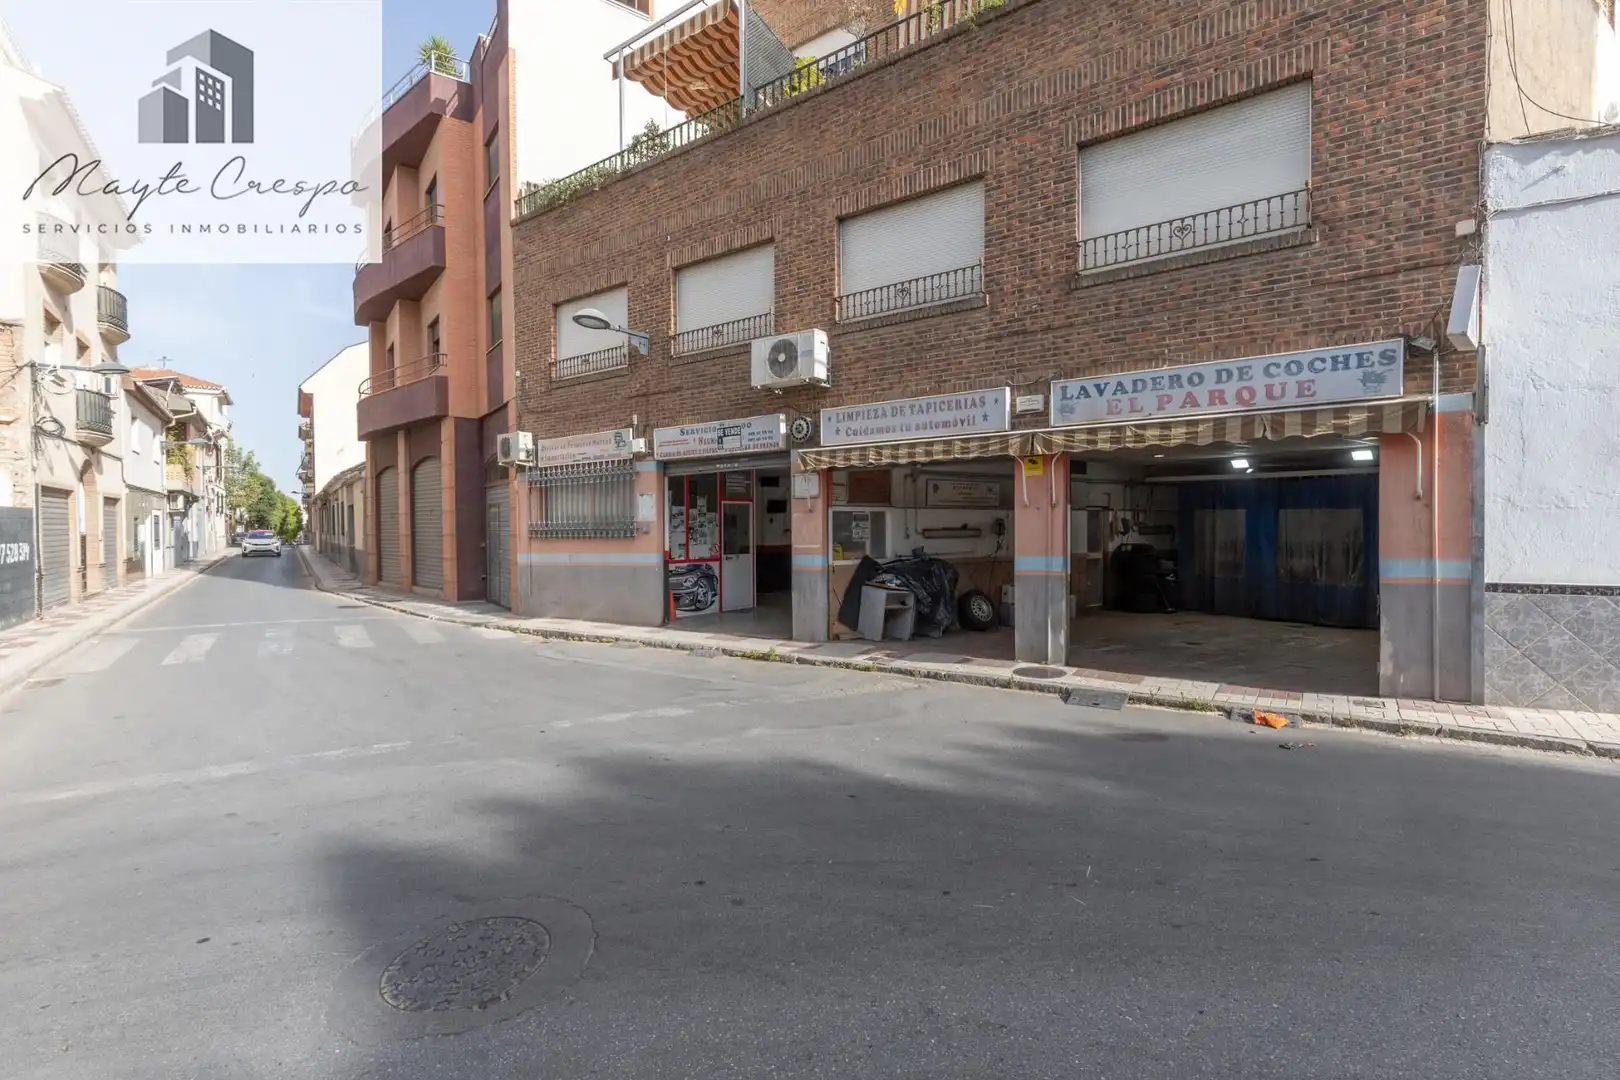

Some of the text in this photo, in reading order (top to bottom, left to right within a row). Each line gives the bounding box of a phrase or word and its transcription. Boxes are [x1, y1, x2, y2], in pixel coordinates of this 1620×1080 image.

[1060, 348, 1397, 401] LAVADERO DE COCHES
[1106, 379, 1317, 416] EL PARQUE
[836, 406, 888, 424] LIMPIEZA
[891, 405, 907, 418] DE
[717, 429, 724, 437] SE
[725, 427, 741, 436] VENDE
